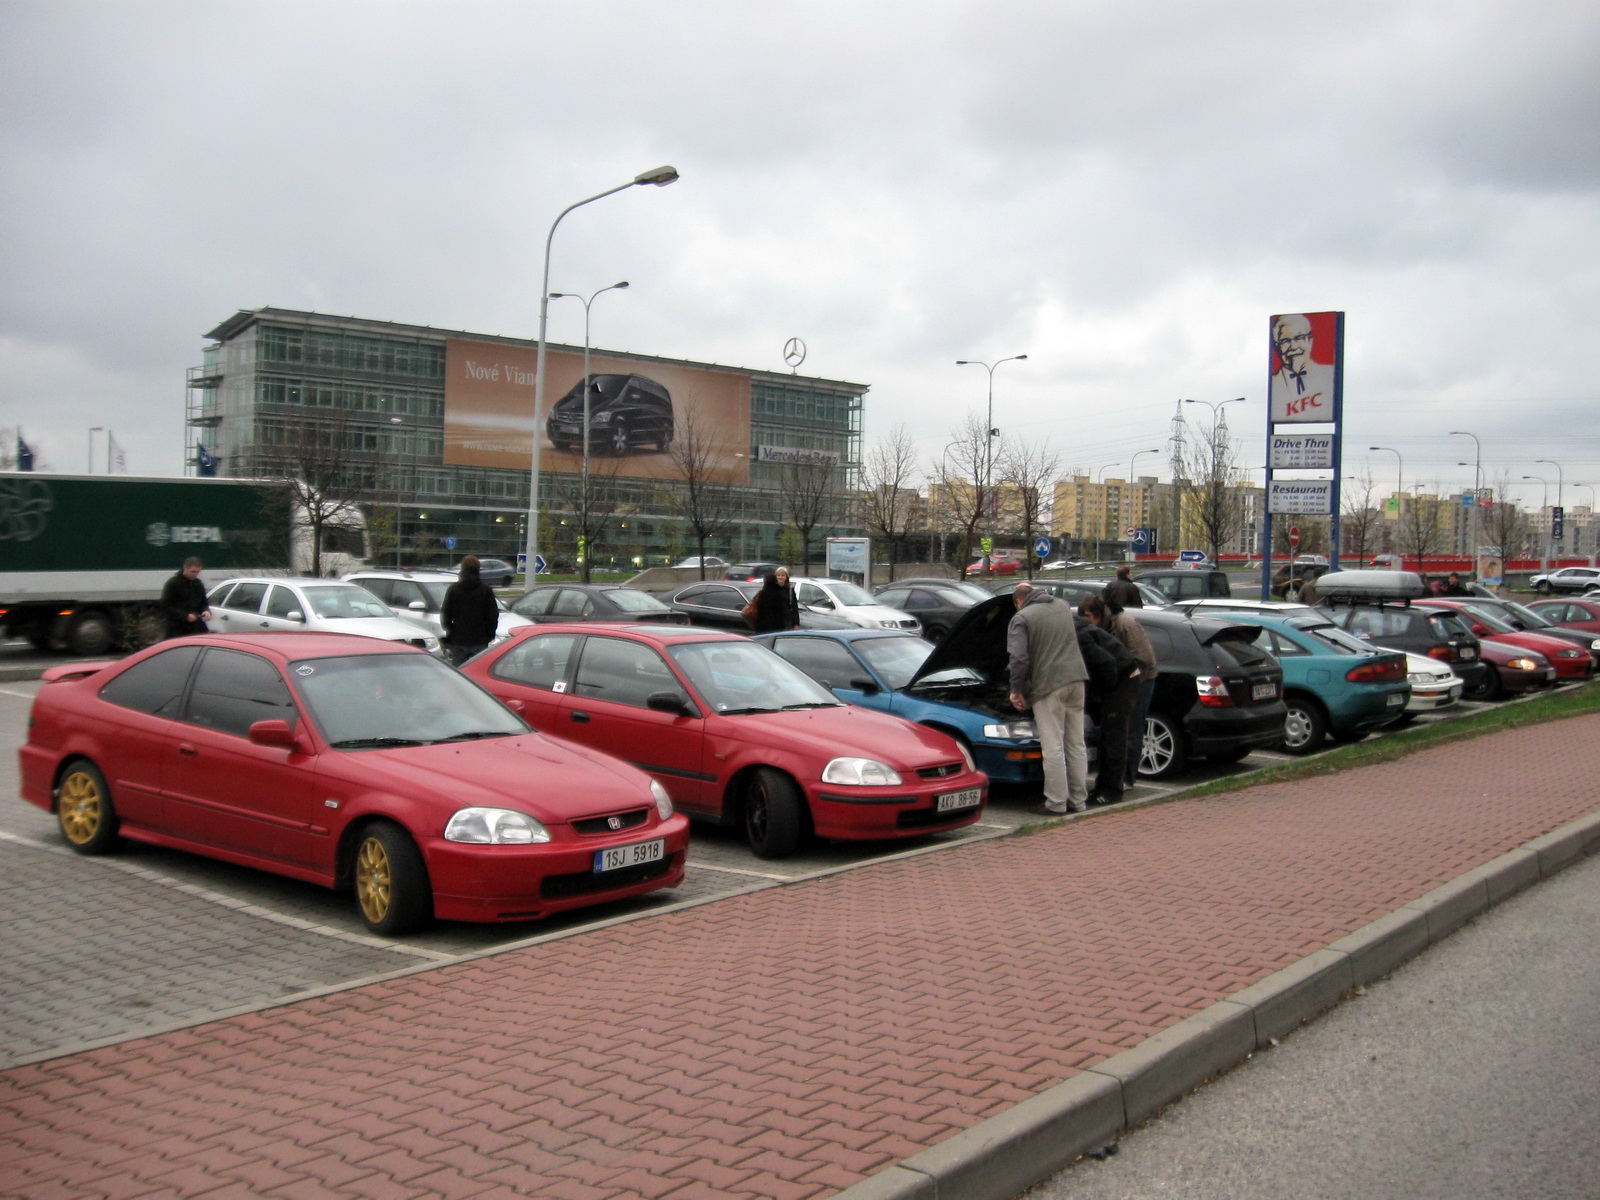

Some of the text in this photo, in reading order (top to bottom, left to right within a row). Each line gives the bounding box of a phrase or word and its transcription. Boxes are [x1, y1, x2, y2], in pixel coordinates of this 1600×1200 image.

[464, 360, 537, 387] Nové Vian
[1286, 392, 1323, 417] KFC
[1274, 438, 1329, 449] Drive Thru
[1272, 484, 1328, 494] Restaurant
[605, 842, 660, 868] 1SJ 5918
